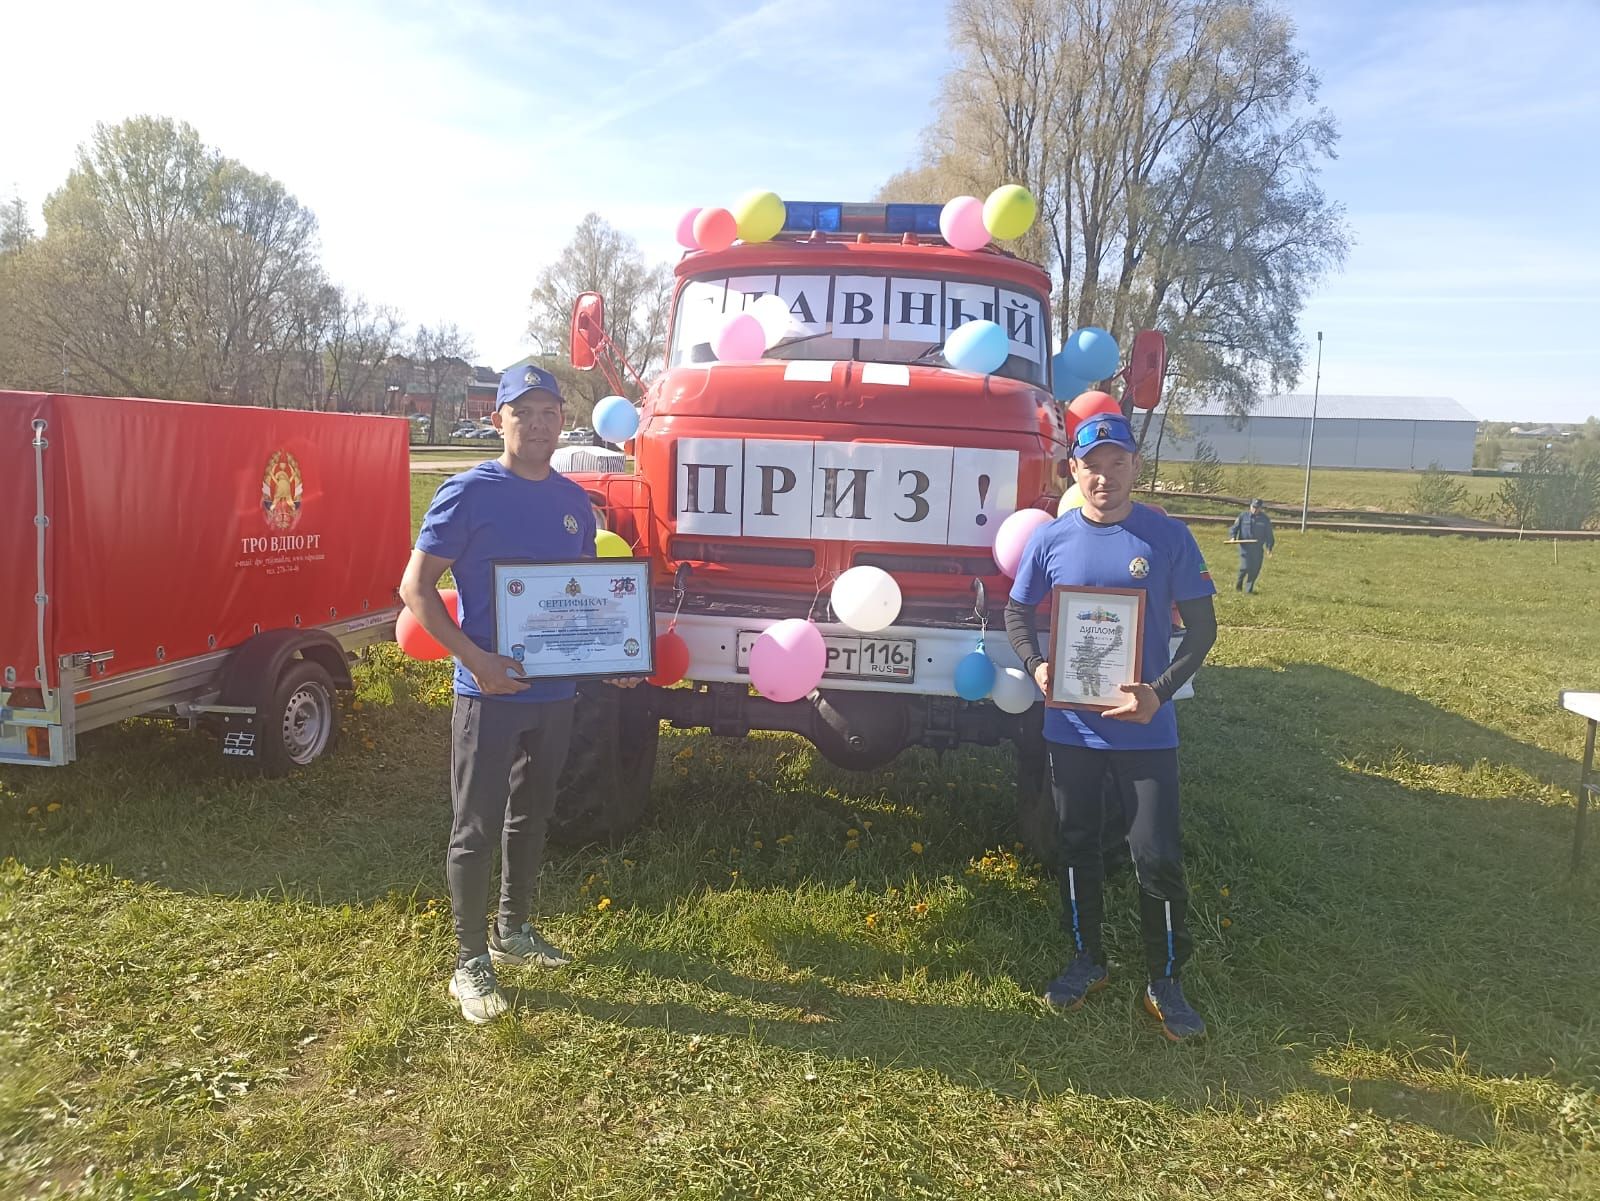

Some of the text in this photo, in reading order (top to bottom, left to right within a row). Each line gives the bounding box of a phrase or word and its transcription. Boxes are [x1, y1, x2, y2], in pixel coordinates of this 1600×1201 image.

[703, 289, 1036, 348] АВНЫЙ
[241, 535, 320, 553] ТРО ВДПО РТ
[538, 598, 609, 608] СЕРТИФИКАТ
[1080, 626, 1115, 634] ДИПЛОМ
[863, 642, 904, 665] 116
[871, 664, 892, 673] RUS
